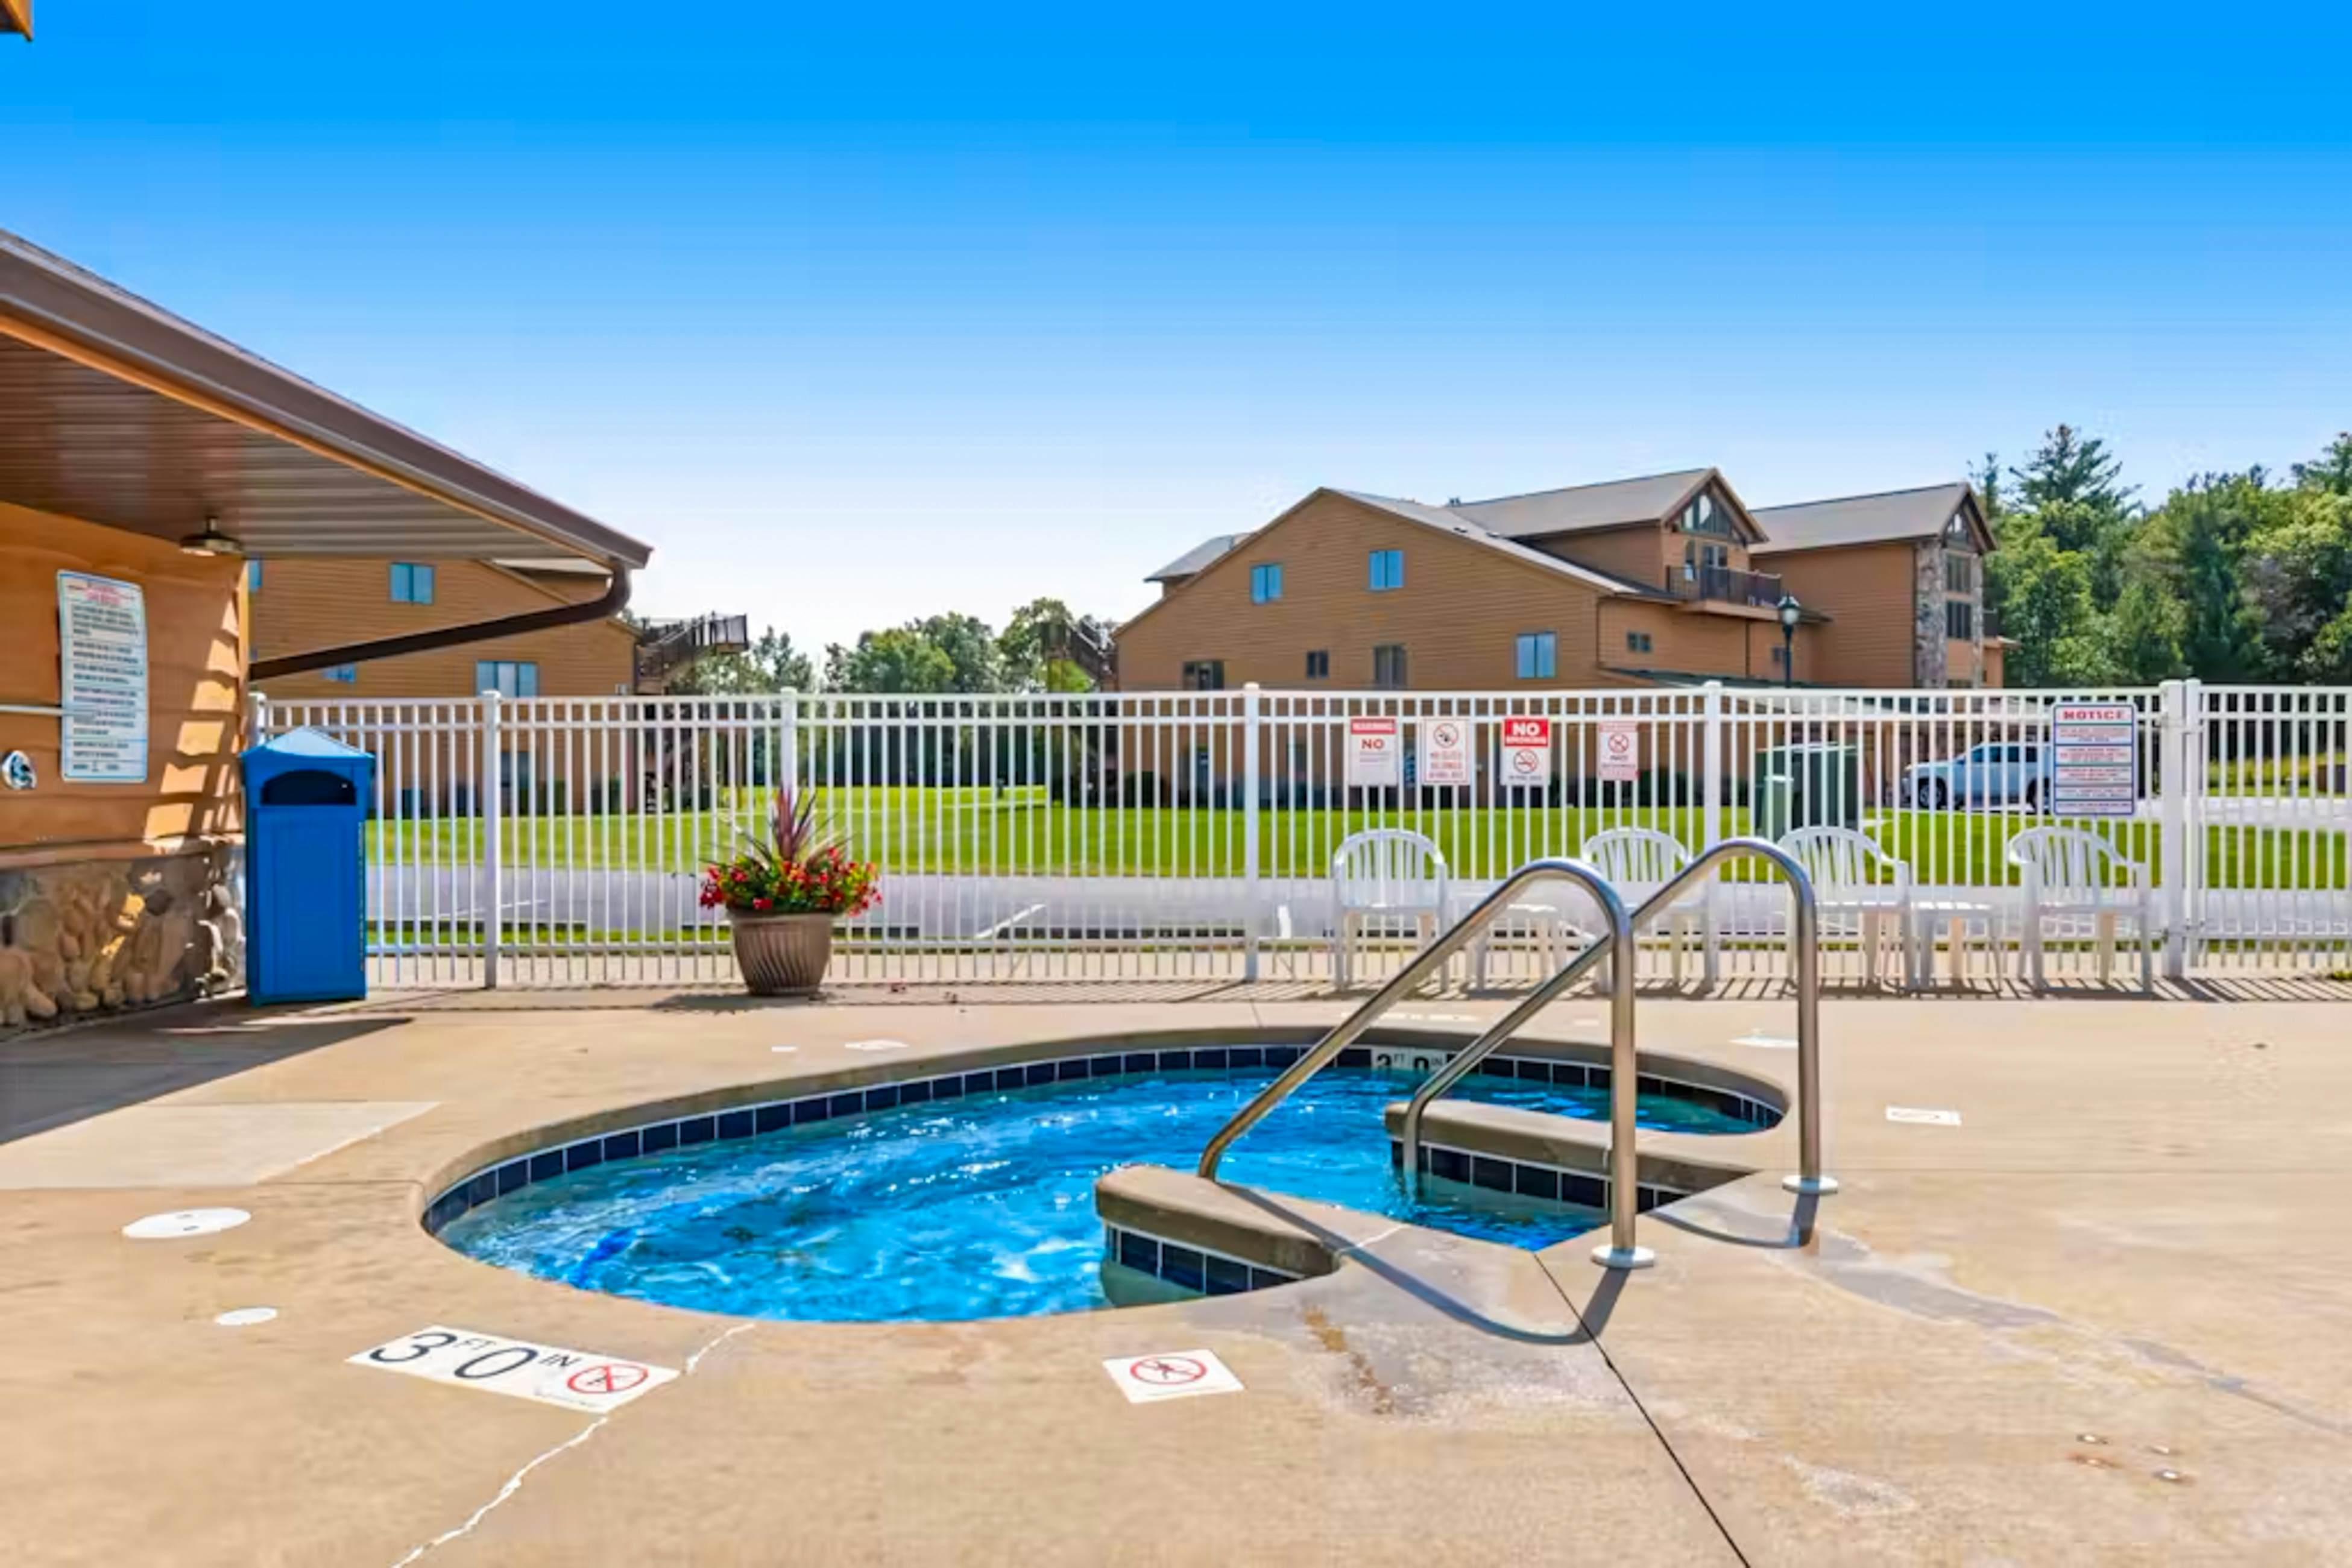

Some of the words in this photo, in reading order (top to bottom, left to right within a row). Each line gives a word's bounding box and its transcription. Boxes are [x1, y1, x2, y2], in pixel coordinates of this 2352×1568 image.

[1512, 722, 1540, 735] NO
[1361, 738, 1385, 749] NO
[369, 1332, 458, 1362] 3
[454, 1347, 538, 1379] 0
[538, 1353, 582, 1367] IN
